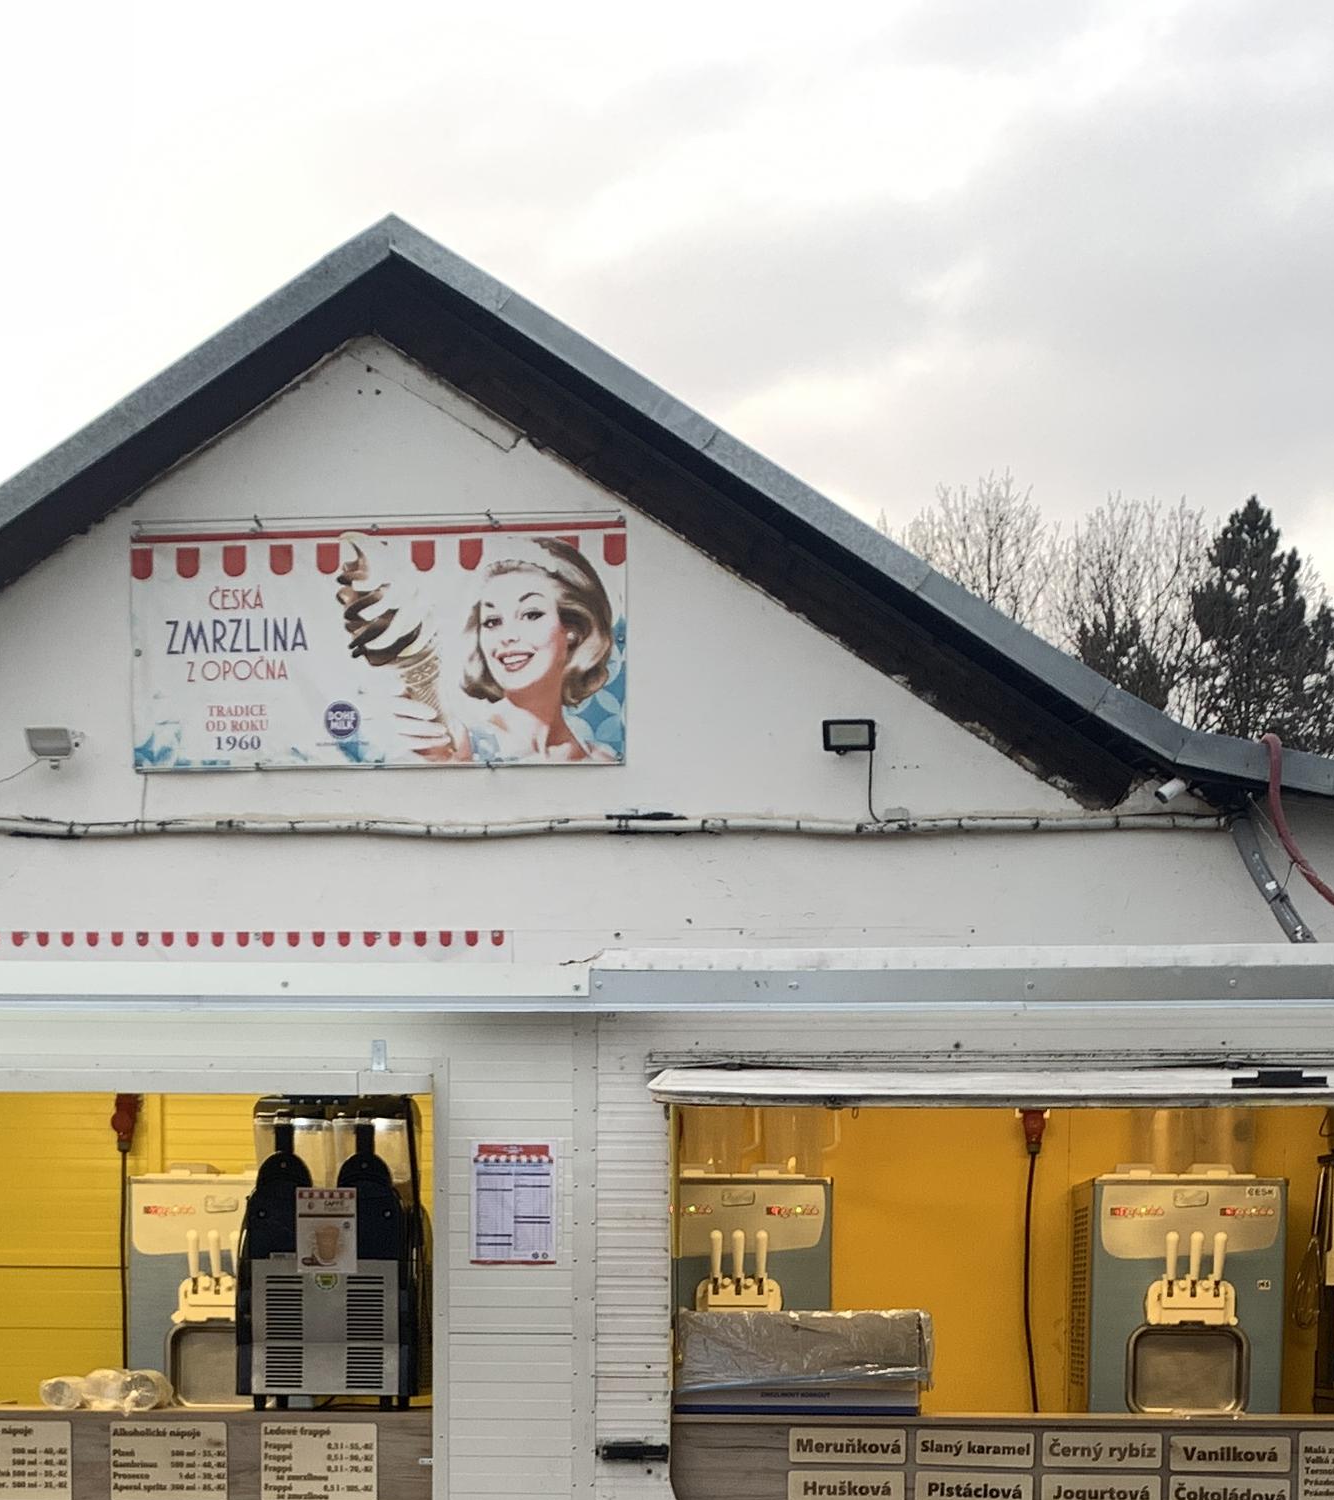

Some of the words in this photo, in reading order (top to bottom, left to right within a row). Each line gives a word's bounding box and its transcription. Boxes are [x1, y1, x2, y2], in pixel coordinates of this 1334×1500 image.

[208, 584, 264, 611] ČESKÁ
[165, 616, 309, 655] ZMRZLINA
[186, 660, 196, 683] Z
[201, 655, 289, 682] OPOČNA
[207, 703, 268, 718] TRADICE
[205, 719, 228, 733] OD
[230, 718, 269, 733] ROKU
[329, 720, 355, 731] MILK
[215, 734, 262, 751] 1960
[1, 1425, 34, 1437] nápoje
[112, 1427, 167, 1437] Alkoholické
[169, 1428, 202, 1440] nápoje
[264, 1426, 298, 1436] Ledové
[299, 1426, 332, 1438] frappé
[795, 1438, 902, 1455] Meruňková
[920, 1439, 964, 1457] Slaný
[967, 1440, 1032, 1456] karamel
[1048, 1438, 1104, 1462] Černý
[1108, 1442, 1157, 1462] rybíz
[1181, 1446, 1279, 1463] Vanilková
[1304, 1446, 1326, 1455] Malá
[1305, 1456, 1329, 1465] Velká
[802, 1480, 893, 1497] Hrušková
[927, 1481, 1023, 1500] Pistáciová
